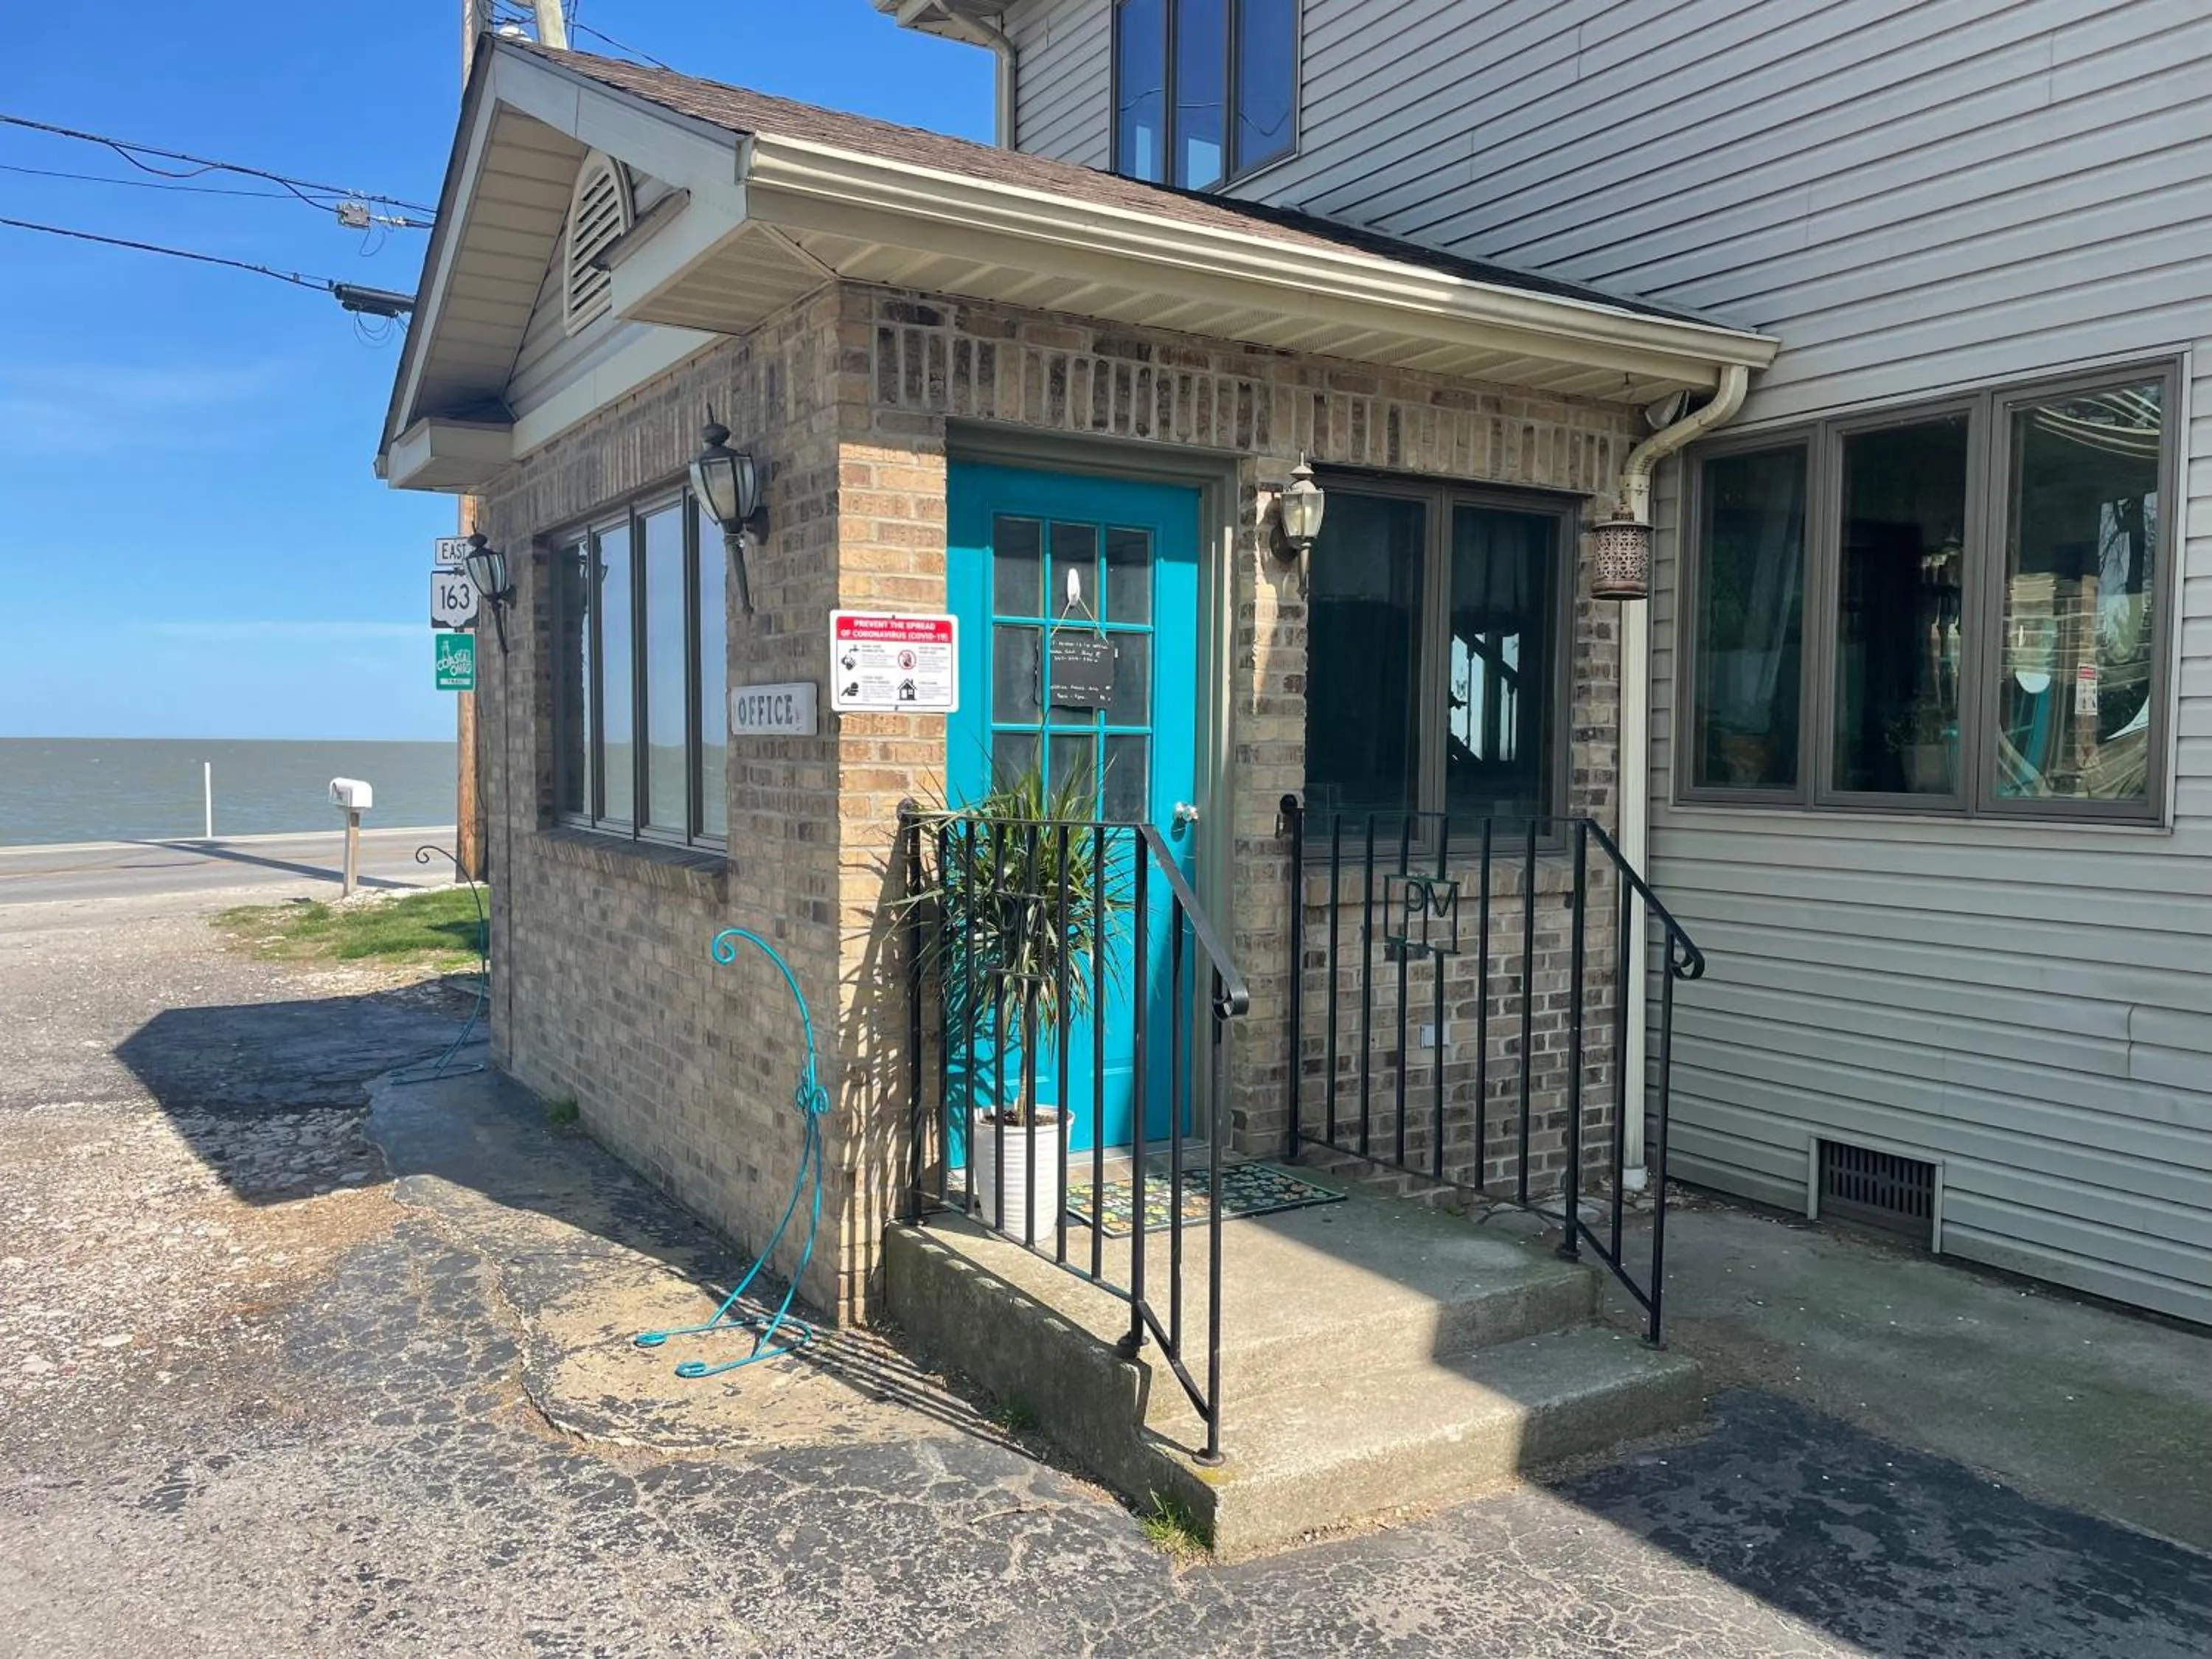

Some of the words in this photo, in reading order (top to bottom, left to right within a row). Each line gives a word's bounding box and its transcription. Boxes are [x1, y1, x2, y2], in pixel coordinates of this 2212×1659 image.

[442, 542, 466, 560] EAST
[440, 583, 470, 610] 163
[853, 619, 888, 627] PREVENT
[906, 622, 936, 630] SPREAD
[852, 630, 906, 639] CORONAVIRUS
[738, 694, 793, 726] OFFICE
